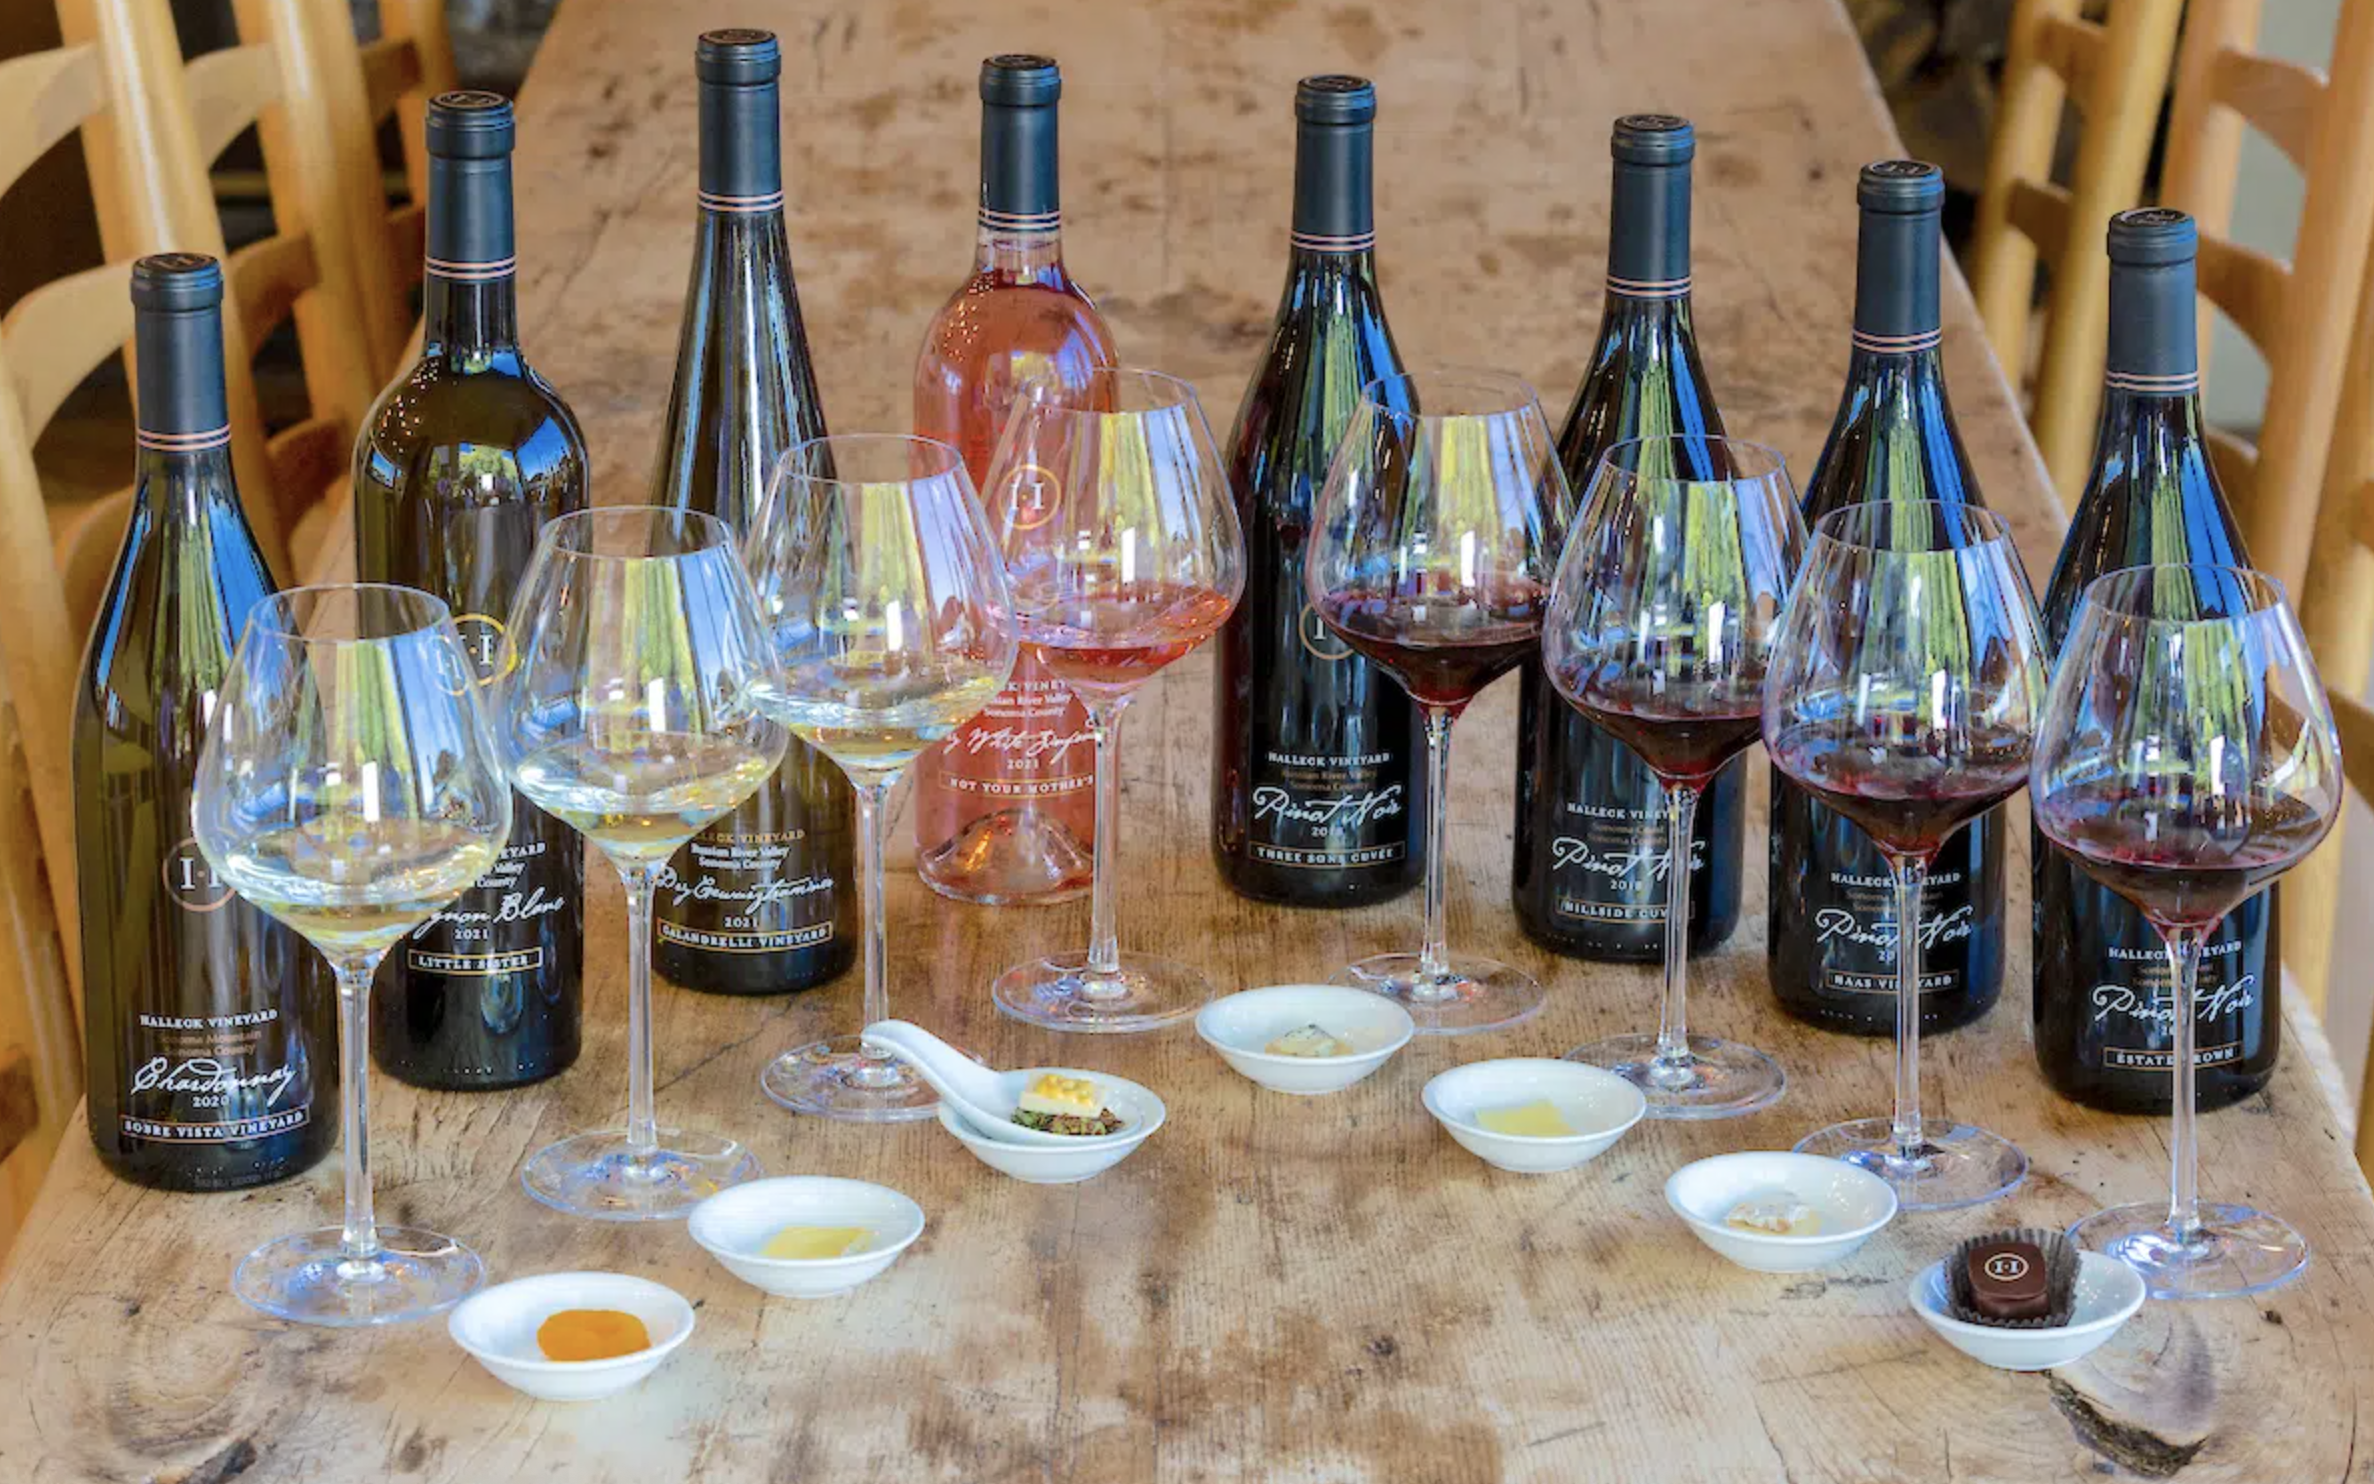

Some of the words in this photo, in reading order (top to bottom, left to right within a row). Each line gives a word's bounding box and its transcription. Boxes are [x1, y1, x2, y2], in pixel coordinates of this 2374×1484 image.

[1024, 679, 1067, 691] VINEY
[1007, 759, 1039, 770] 2021
[1268, 752, 1325, 766] HALLECK
[1329, 752, 1390, 766] VINEYARD
[951, 778, 977, 790] NOT
[982, 783, 1021, 793] YOUR
[1253, 786, 1354, 823] Pinot
[1342, 785, 1402, 825] Noir
[1566, 803, 1626, 819] HALLECK
[1629, 809, 1669, 819] VINEY
[740, 829, 806, 844] VINEYARD
[1258, 848, 1301, 863] THREE
[1307, 853, 1346, 864] SONS
[1552, 837, 1653, 877] Pinot
[1831, 872, 1893, 887] HALLECK
[1563, 903, 1634, 918] HILLSIDE
[1639, 907, 1668, 918] CUV
[724, 917, 759, 928] 2021
[1918, 905, 1974, 949] Noir
[454, 929, 489, 940] 2021
[760, 928, 827, 947] VINEYARD
[418, 955, 471, 969] LITTLE
[1834, 975, 1872, 989] HAAS
[2198, 974, 2254, 1022] Noir
[140, 1014, 203, 1029] HALLECK
[208, 1009, 278, 1027] VINEYARD
[130, 1056, 297, 1107] Chardonnay
[192, 1096, 230, 1108] 2020
[124, 1120, 171, 1138] SOBRE
[177, 1126, 224, 1138] VISTA
[230, 1111, 304, 1136] VINEYARD
